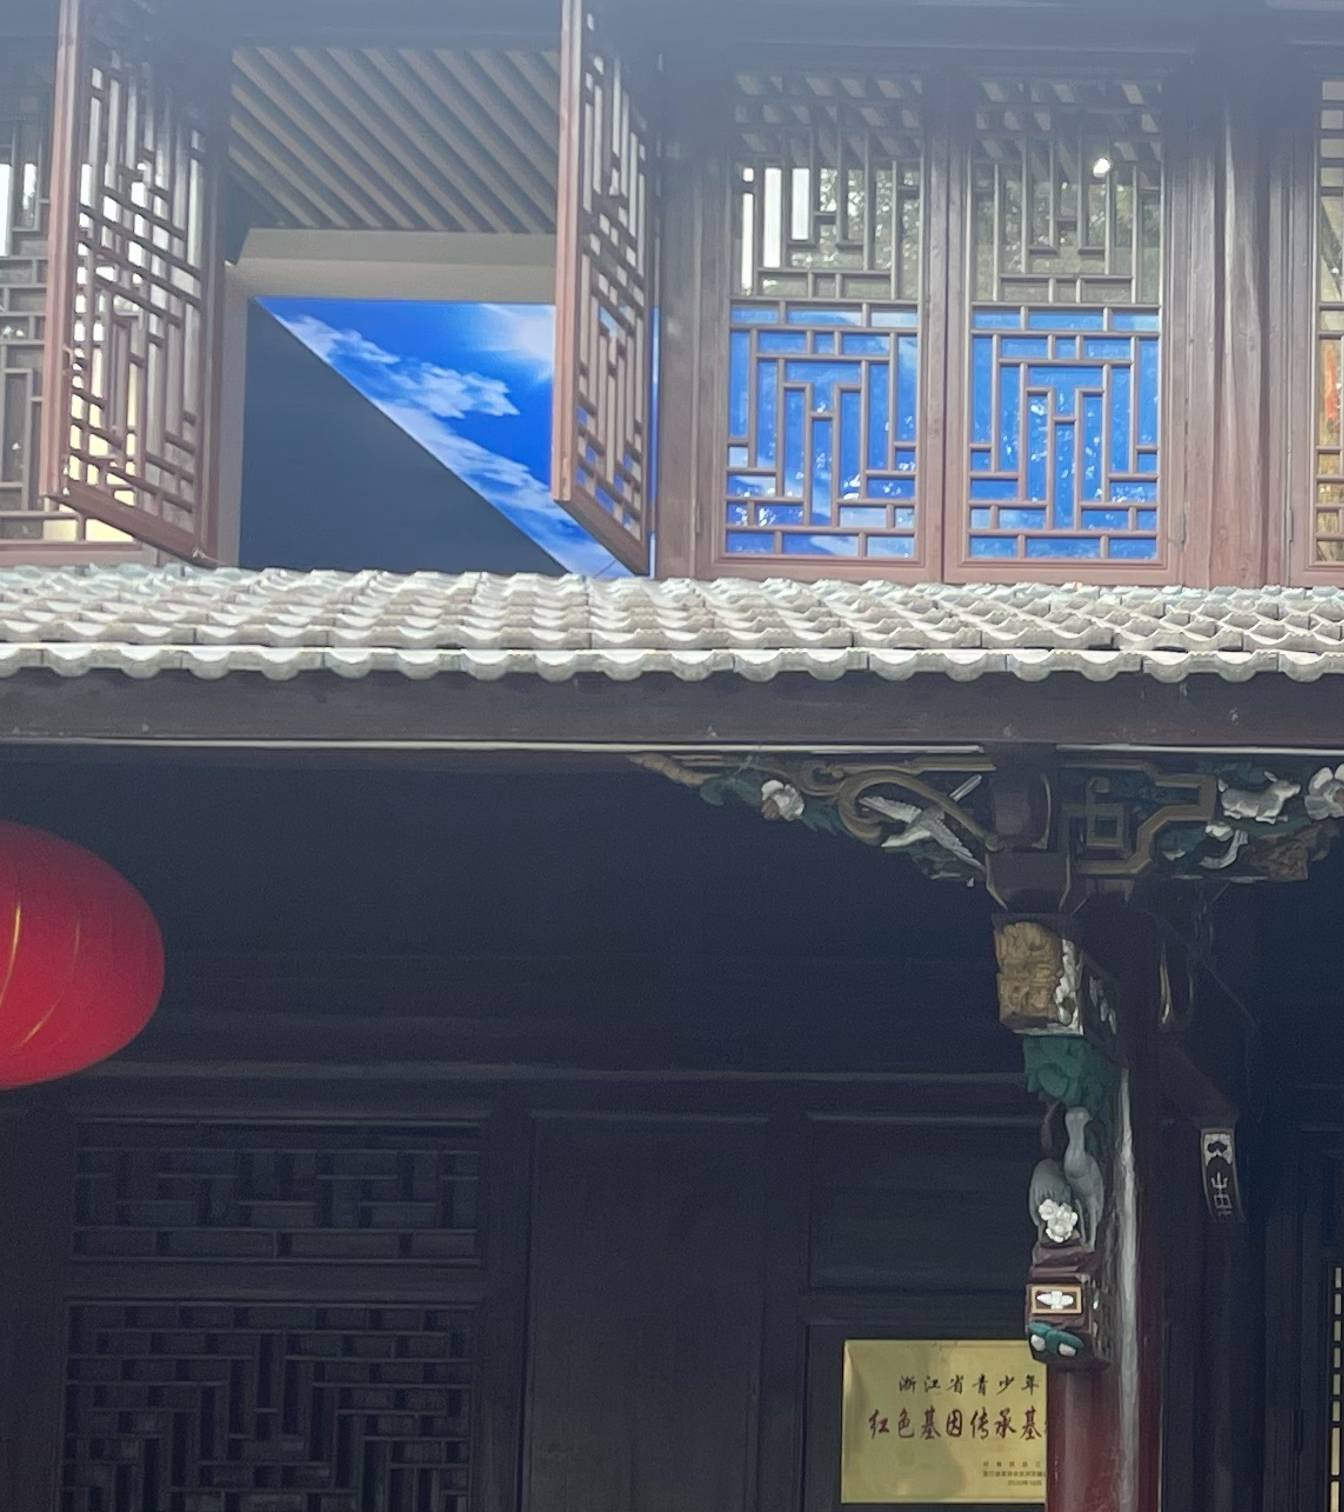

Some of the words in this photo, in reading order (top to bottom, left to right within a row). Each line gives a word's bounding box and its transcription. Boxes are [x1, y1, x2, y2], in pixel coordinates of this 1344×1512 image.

[898, 1374, 1040, 1396] 浙江省青少年
[868, 1404, 1048, 1441] 红色基因传承基
